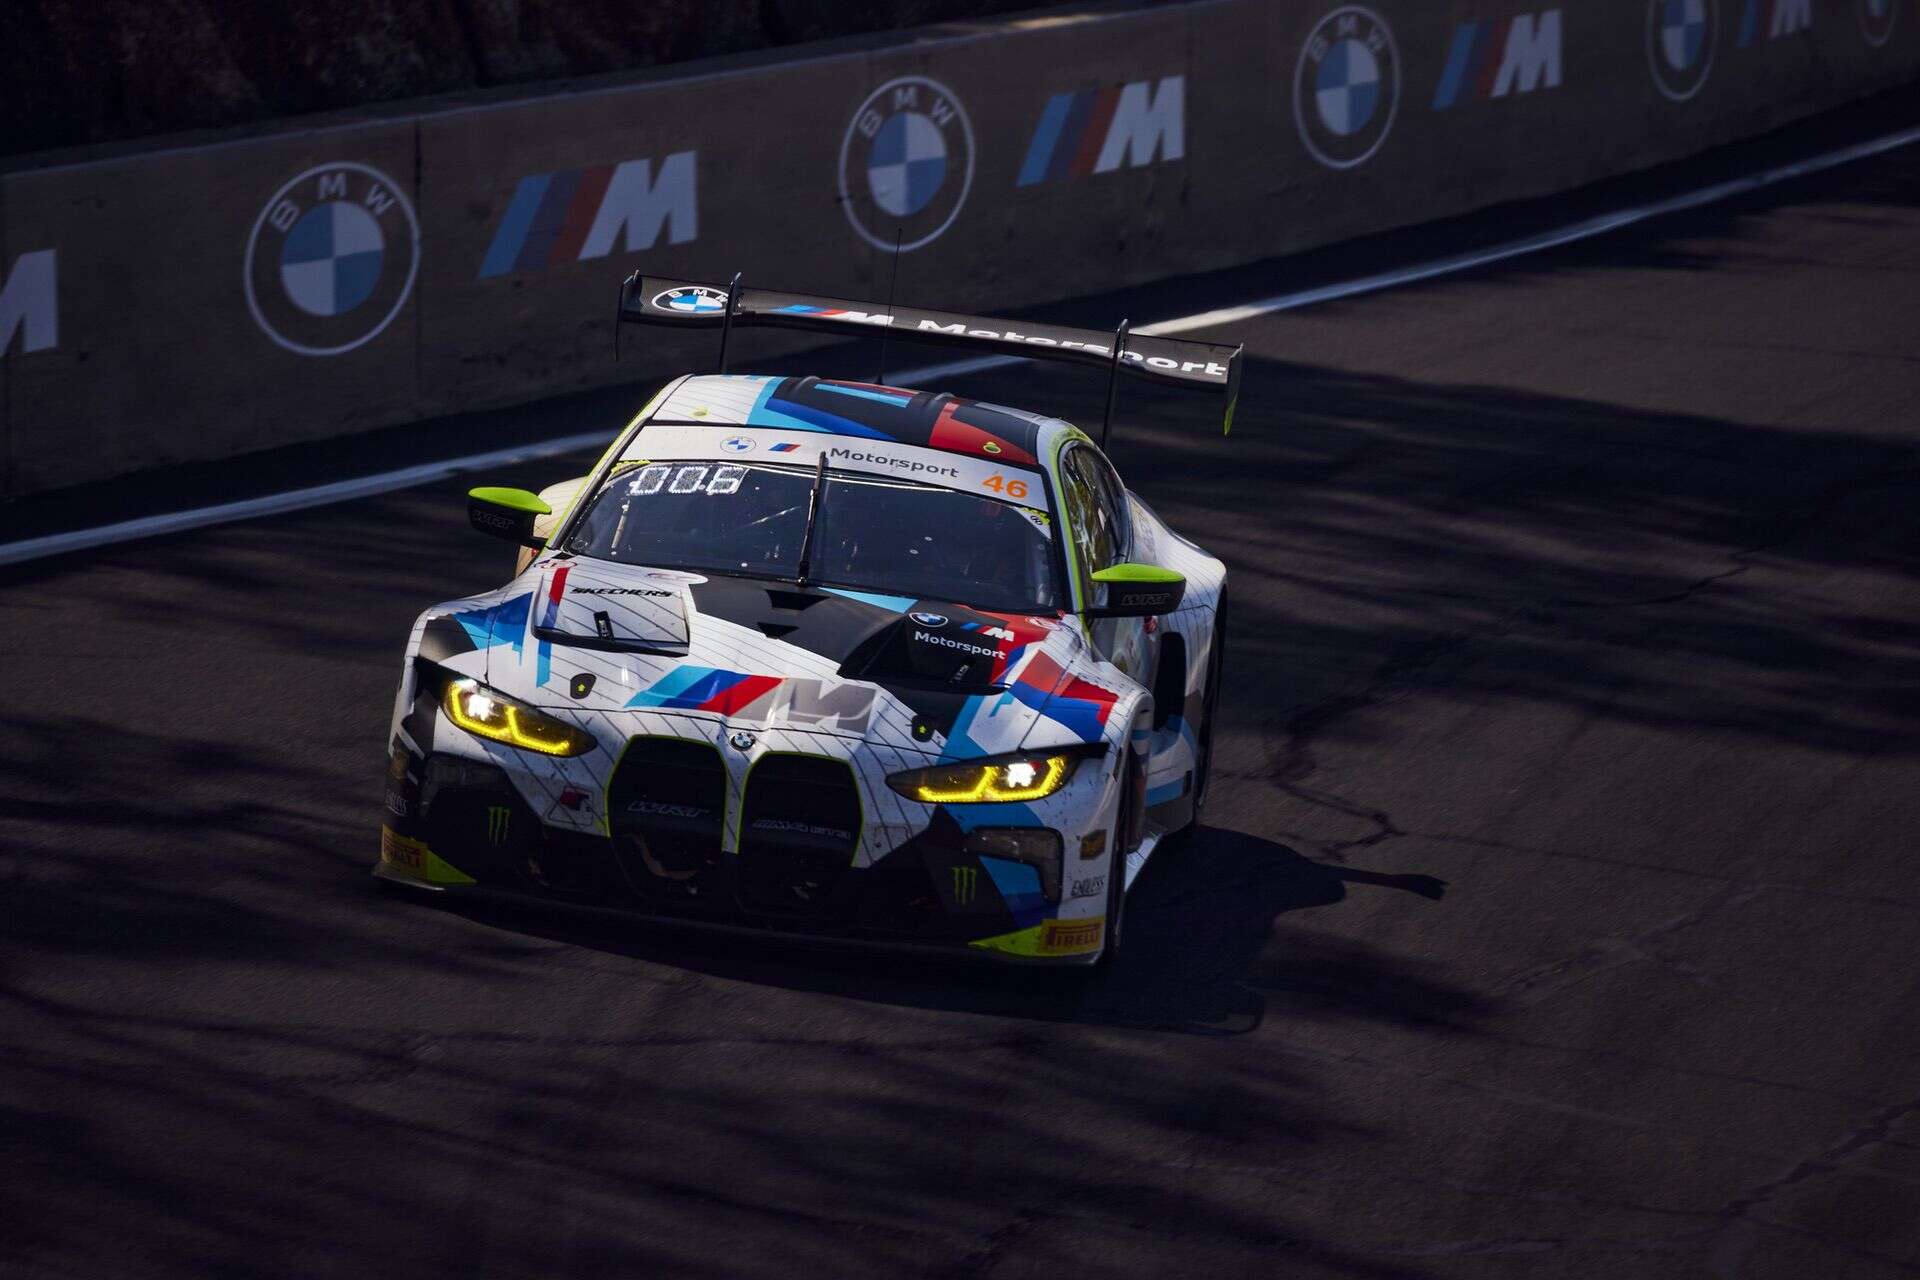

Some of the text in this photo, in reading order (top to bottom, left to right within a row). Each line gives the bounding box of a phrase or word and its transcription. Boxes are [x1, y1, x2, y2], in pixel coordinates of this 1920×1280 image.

[1489, 8, 1560, 98] M
[1092, 74, 1184, 175] M
[577, 150, 698, 261] M
[916, 319, 1228, 377] Motorsport
[829, 447, 960, 478] Motorsport
[981, 474, 1028, 499] 46
[570, 587, 674, 598] SKECHERS
[914, 630, 1007, 660] Motorsport
[982, 626, 1015, 642] M
